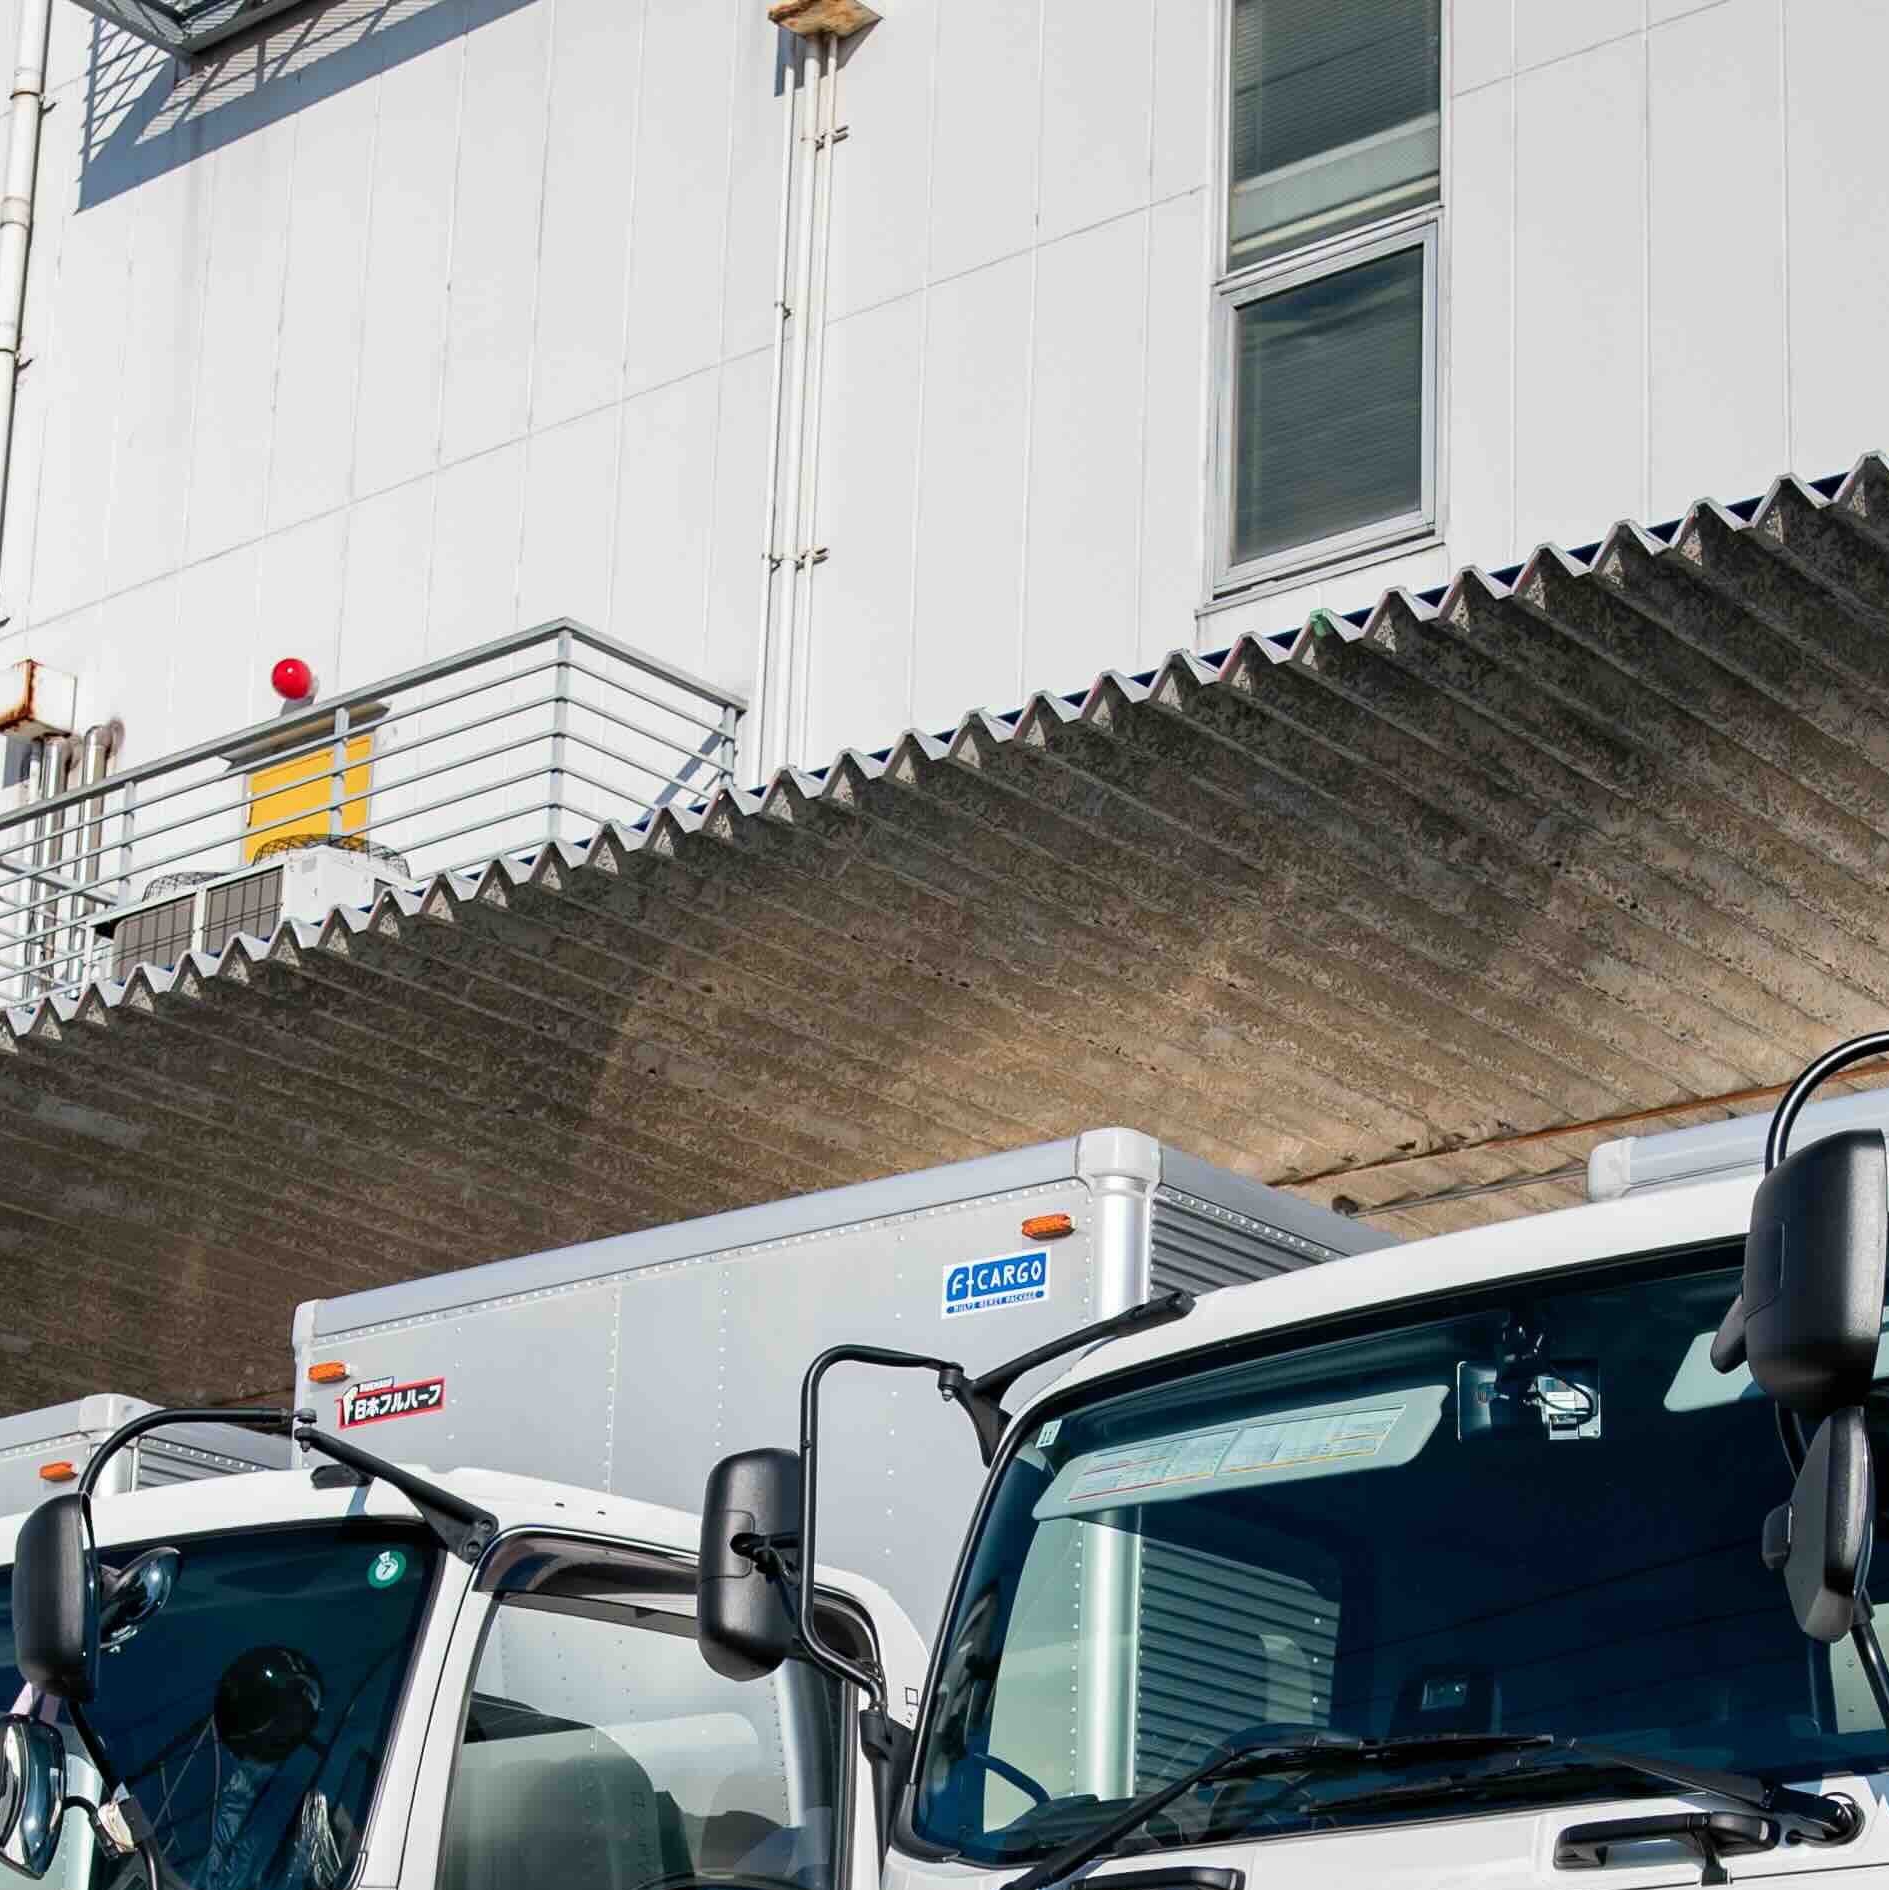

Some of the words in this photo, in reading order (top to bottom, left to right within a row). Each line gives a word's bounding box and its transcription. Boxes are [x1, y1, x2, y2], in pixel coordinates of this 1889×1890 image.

[952, 1260, 1042, 1297] F-CARGO
[354, 1384, 442, 1421] 日本フルハーフ
